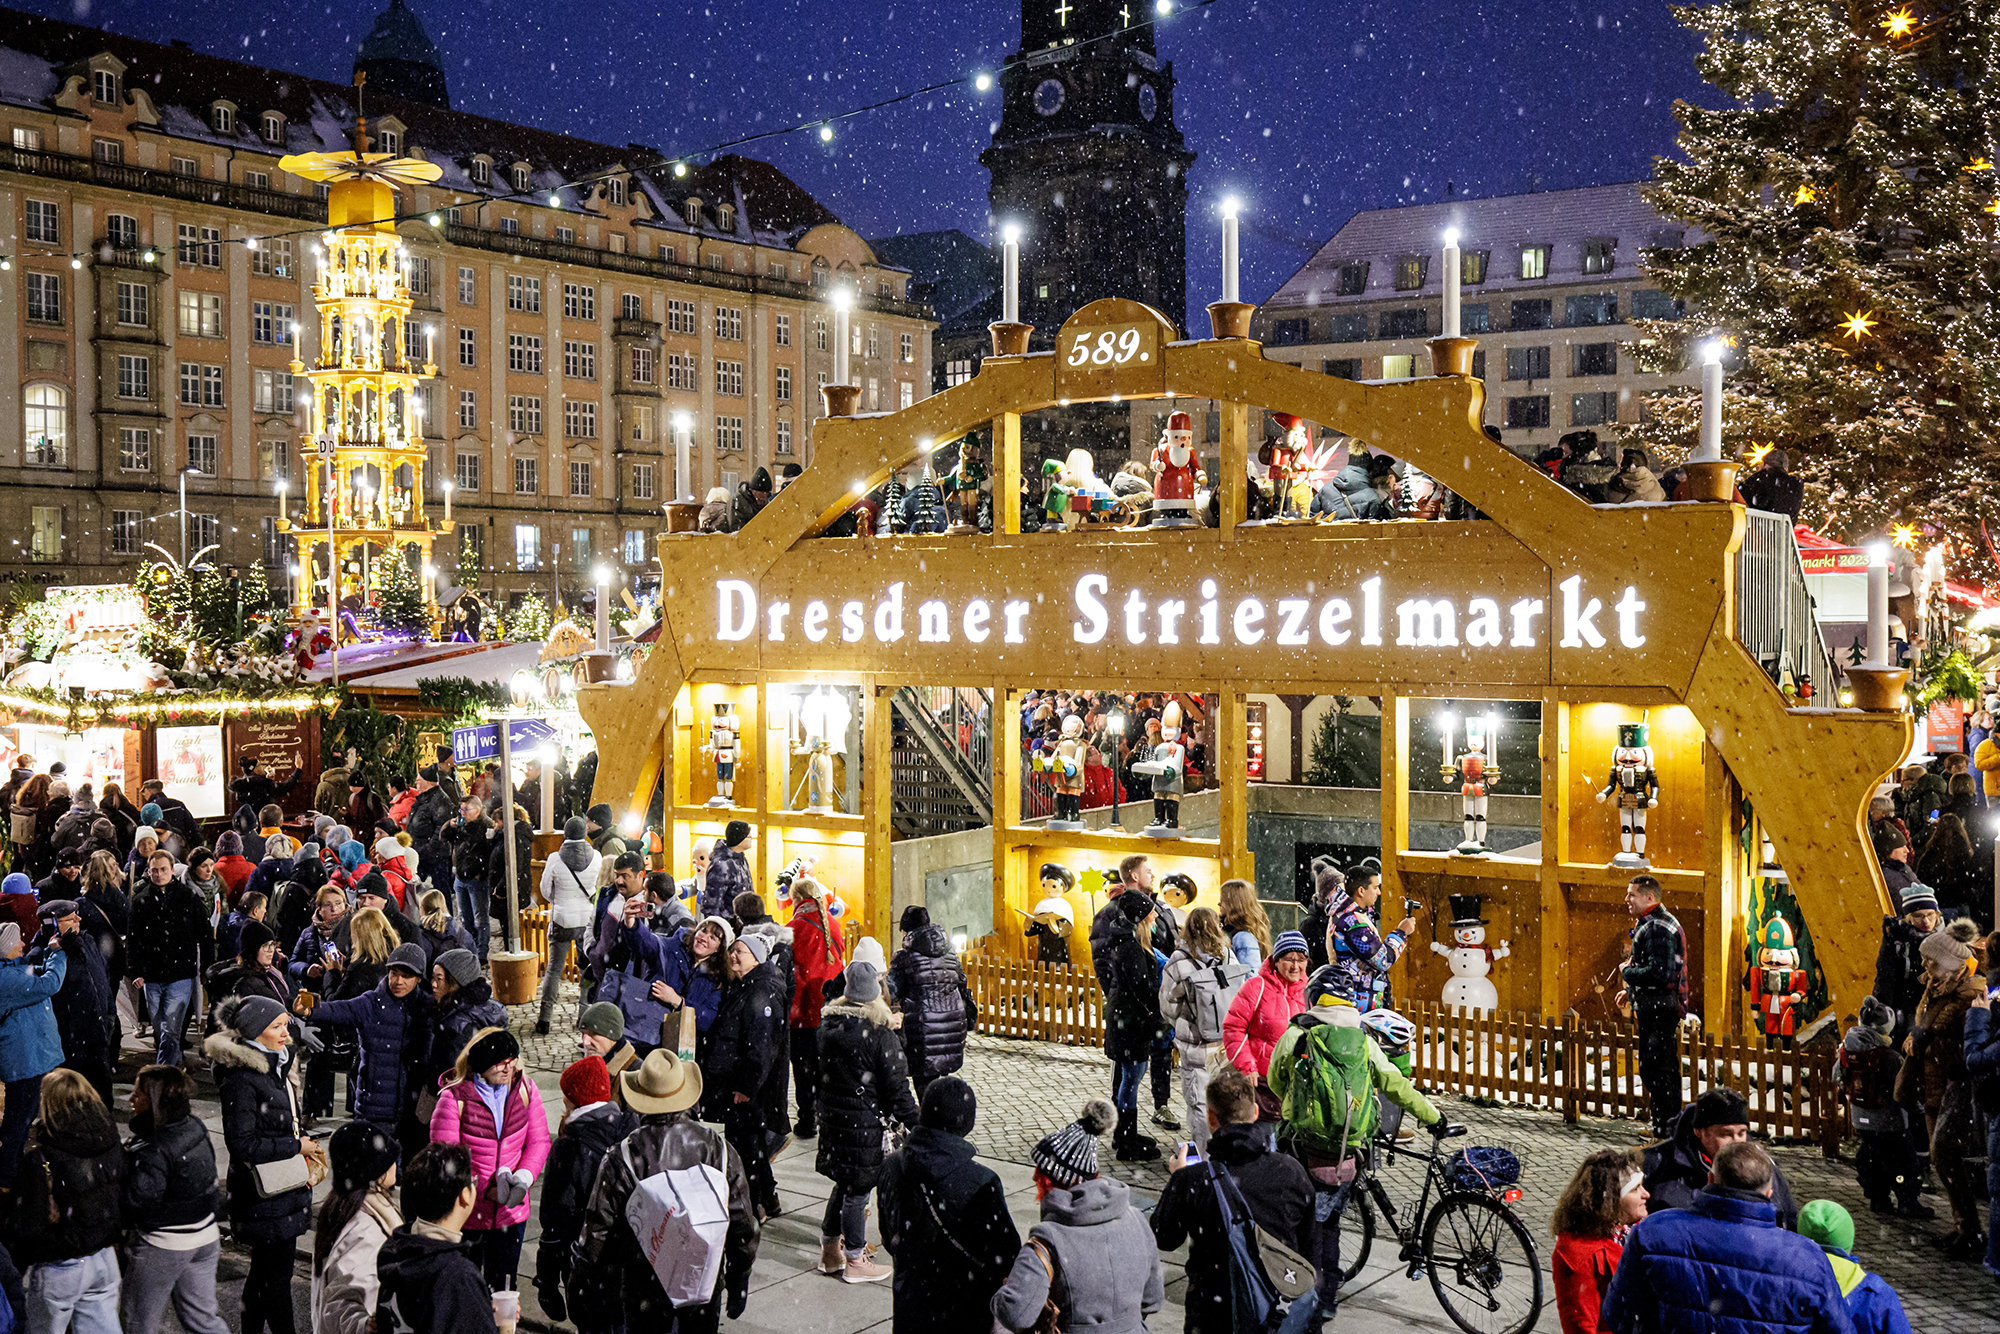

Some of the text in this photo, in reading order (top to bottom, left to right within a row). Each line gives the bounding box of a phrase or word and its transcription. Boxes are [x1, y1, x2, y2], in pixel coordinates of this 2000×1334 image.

[1067, 329, 1149, 366] 589.
[1840, 554, 1869, 565] 2023
[716, 573, 1647, 649] Dresdner Striezelmarkt
[480, 735, 497, 748] WC
